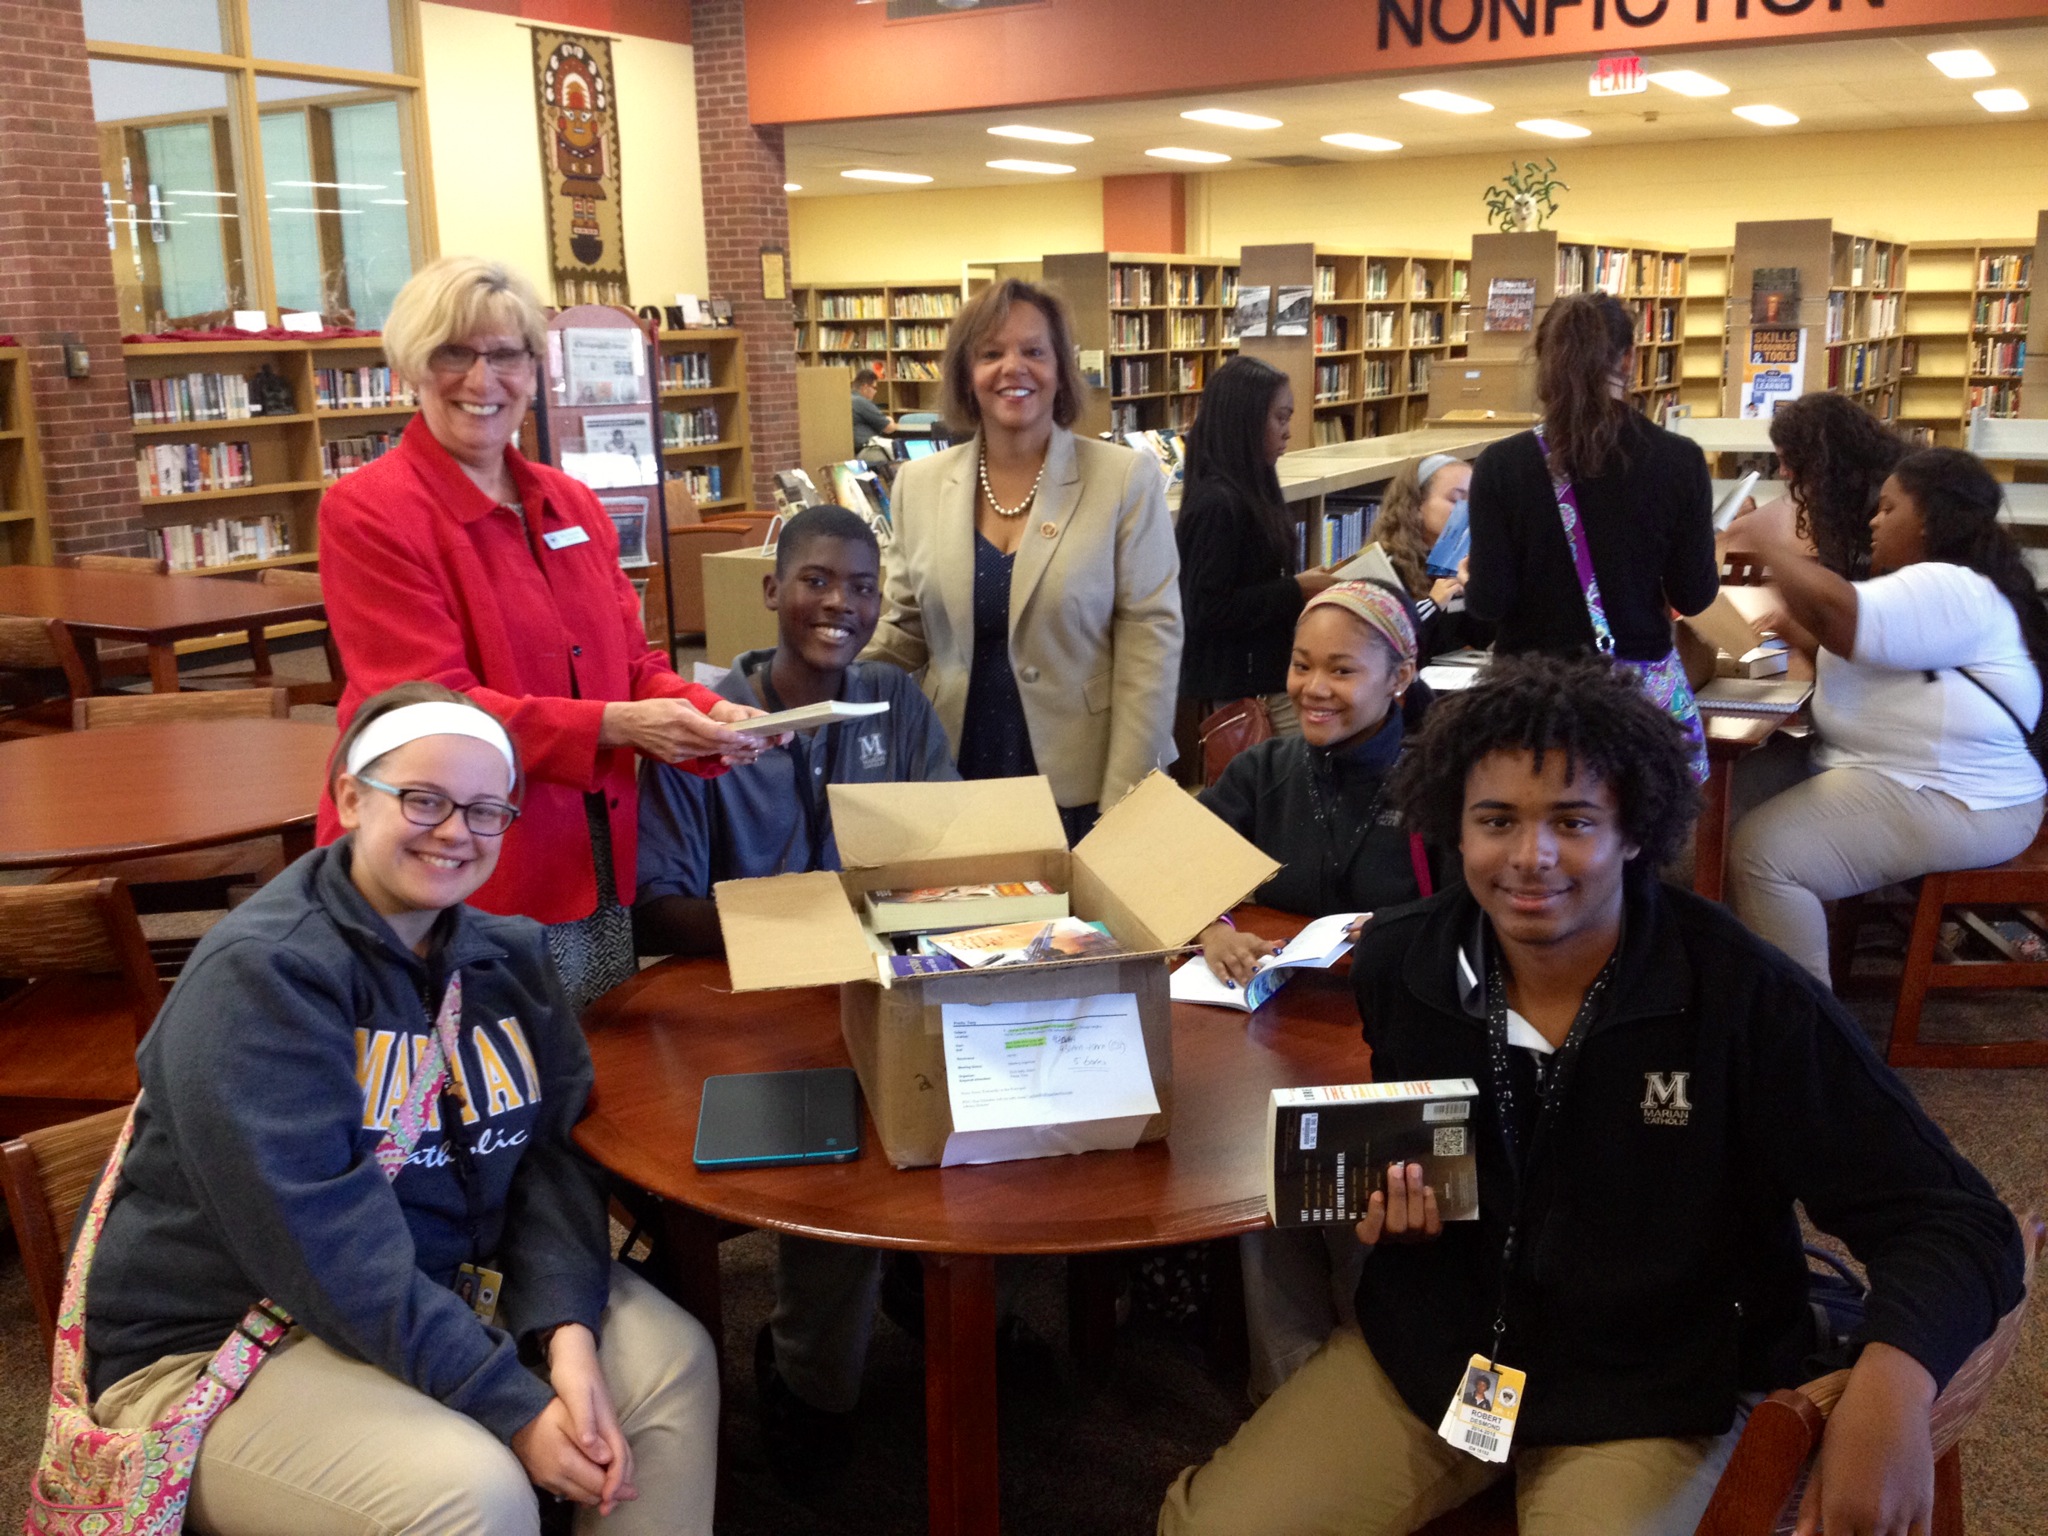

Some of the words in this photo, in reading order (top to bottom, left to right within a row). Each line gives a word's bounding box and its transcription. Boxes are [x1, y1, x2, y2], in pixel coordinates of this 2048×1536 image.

[1598, 57, 1640, 92] EXIT
[1754, 331, 1798, 343] SKILLS
[1765, 351, 1797, 362] TOOLS
[1756, 382, 1791, 390] LEARNER
[858, 733, 886, 760] M
[1322, 1087, 1348, 1101] THE
[1351, 1085, 1380, 1099] FALL
[1384, 1083, 1399, 1097] OF
[1403, 1081, 1434, 1096] FIVE
[1640, 1071, 1692, 1110] M
[1643, 1109, 1689, 1119] MARIAN
[1643, 1117, 1689, 1126] CATHOLIC
[1337, 1178, 1345, 1187] FAR
[1337, 1194, 1345, 1208] FIGHT
[1471, 1409, 1503, 1424] ROBERT
[1469, 1417, 1500, 1431] DESMOND
